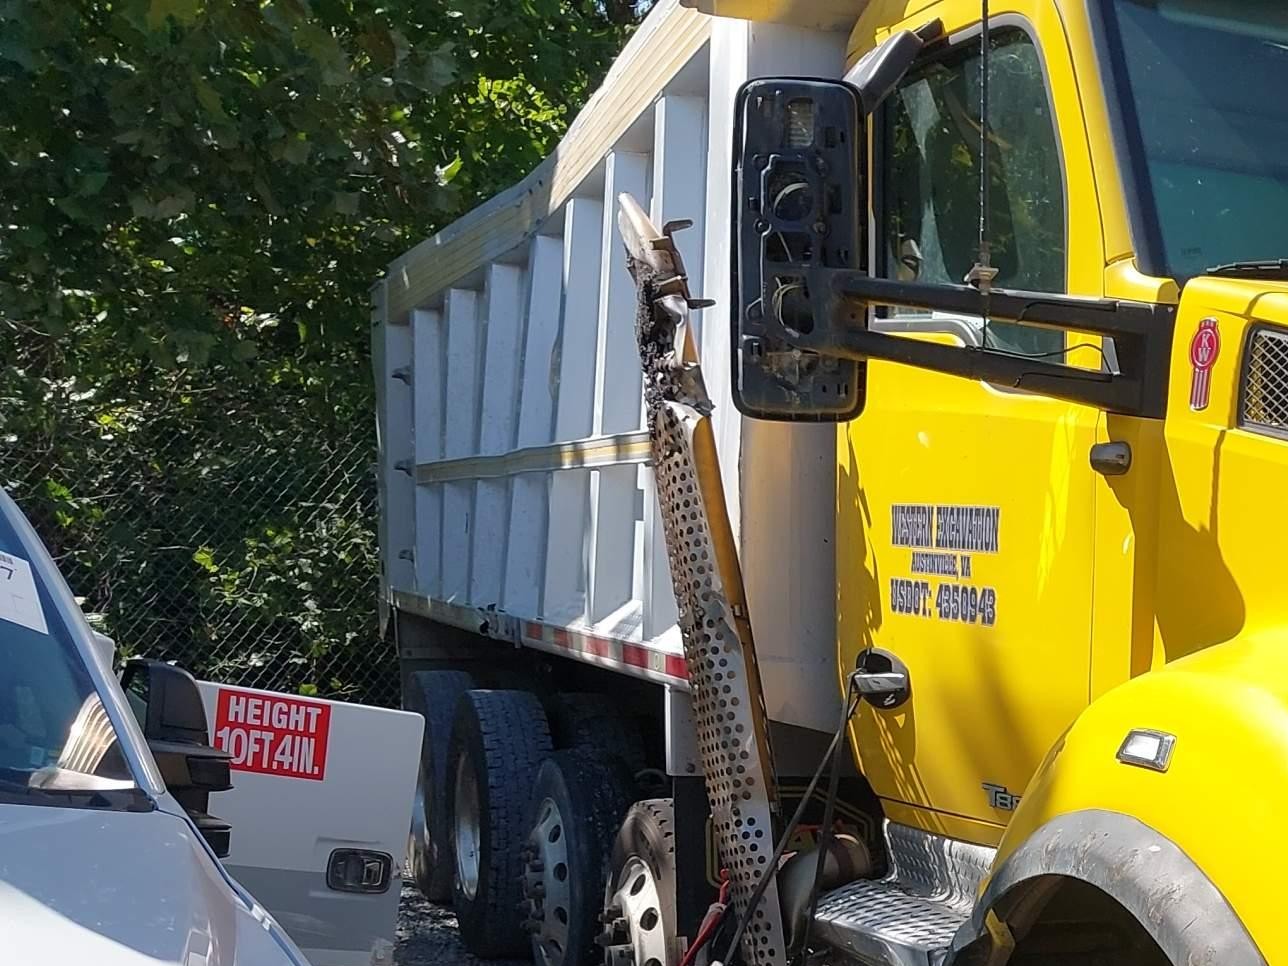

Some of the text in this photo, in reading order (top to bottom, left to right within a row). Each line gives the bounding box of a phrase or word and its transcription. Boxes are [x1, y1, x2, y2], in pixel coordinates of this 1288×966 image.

[890, 505, 1000, 553] WESTERN EXCAVATION
[960, 554, 971, 578] VA
[890, 578, 932, 617] USDOT:
[228, 695, 322, 733] HEIGHT
